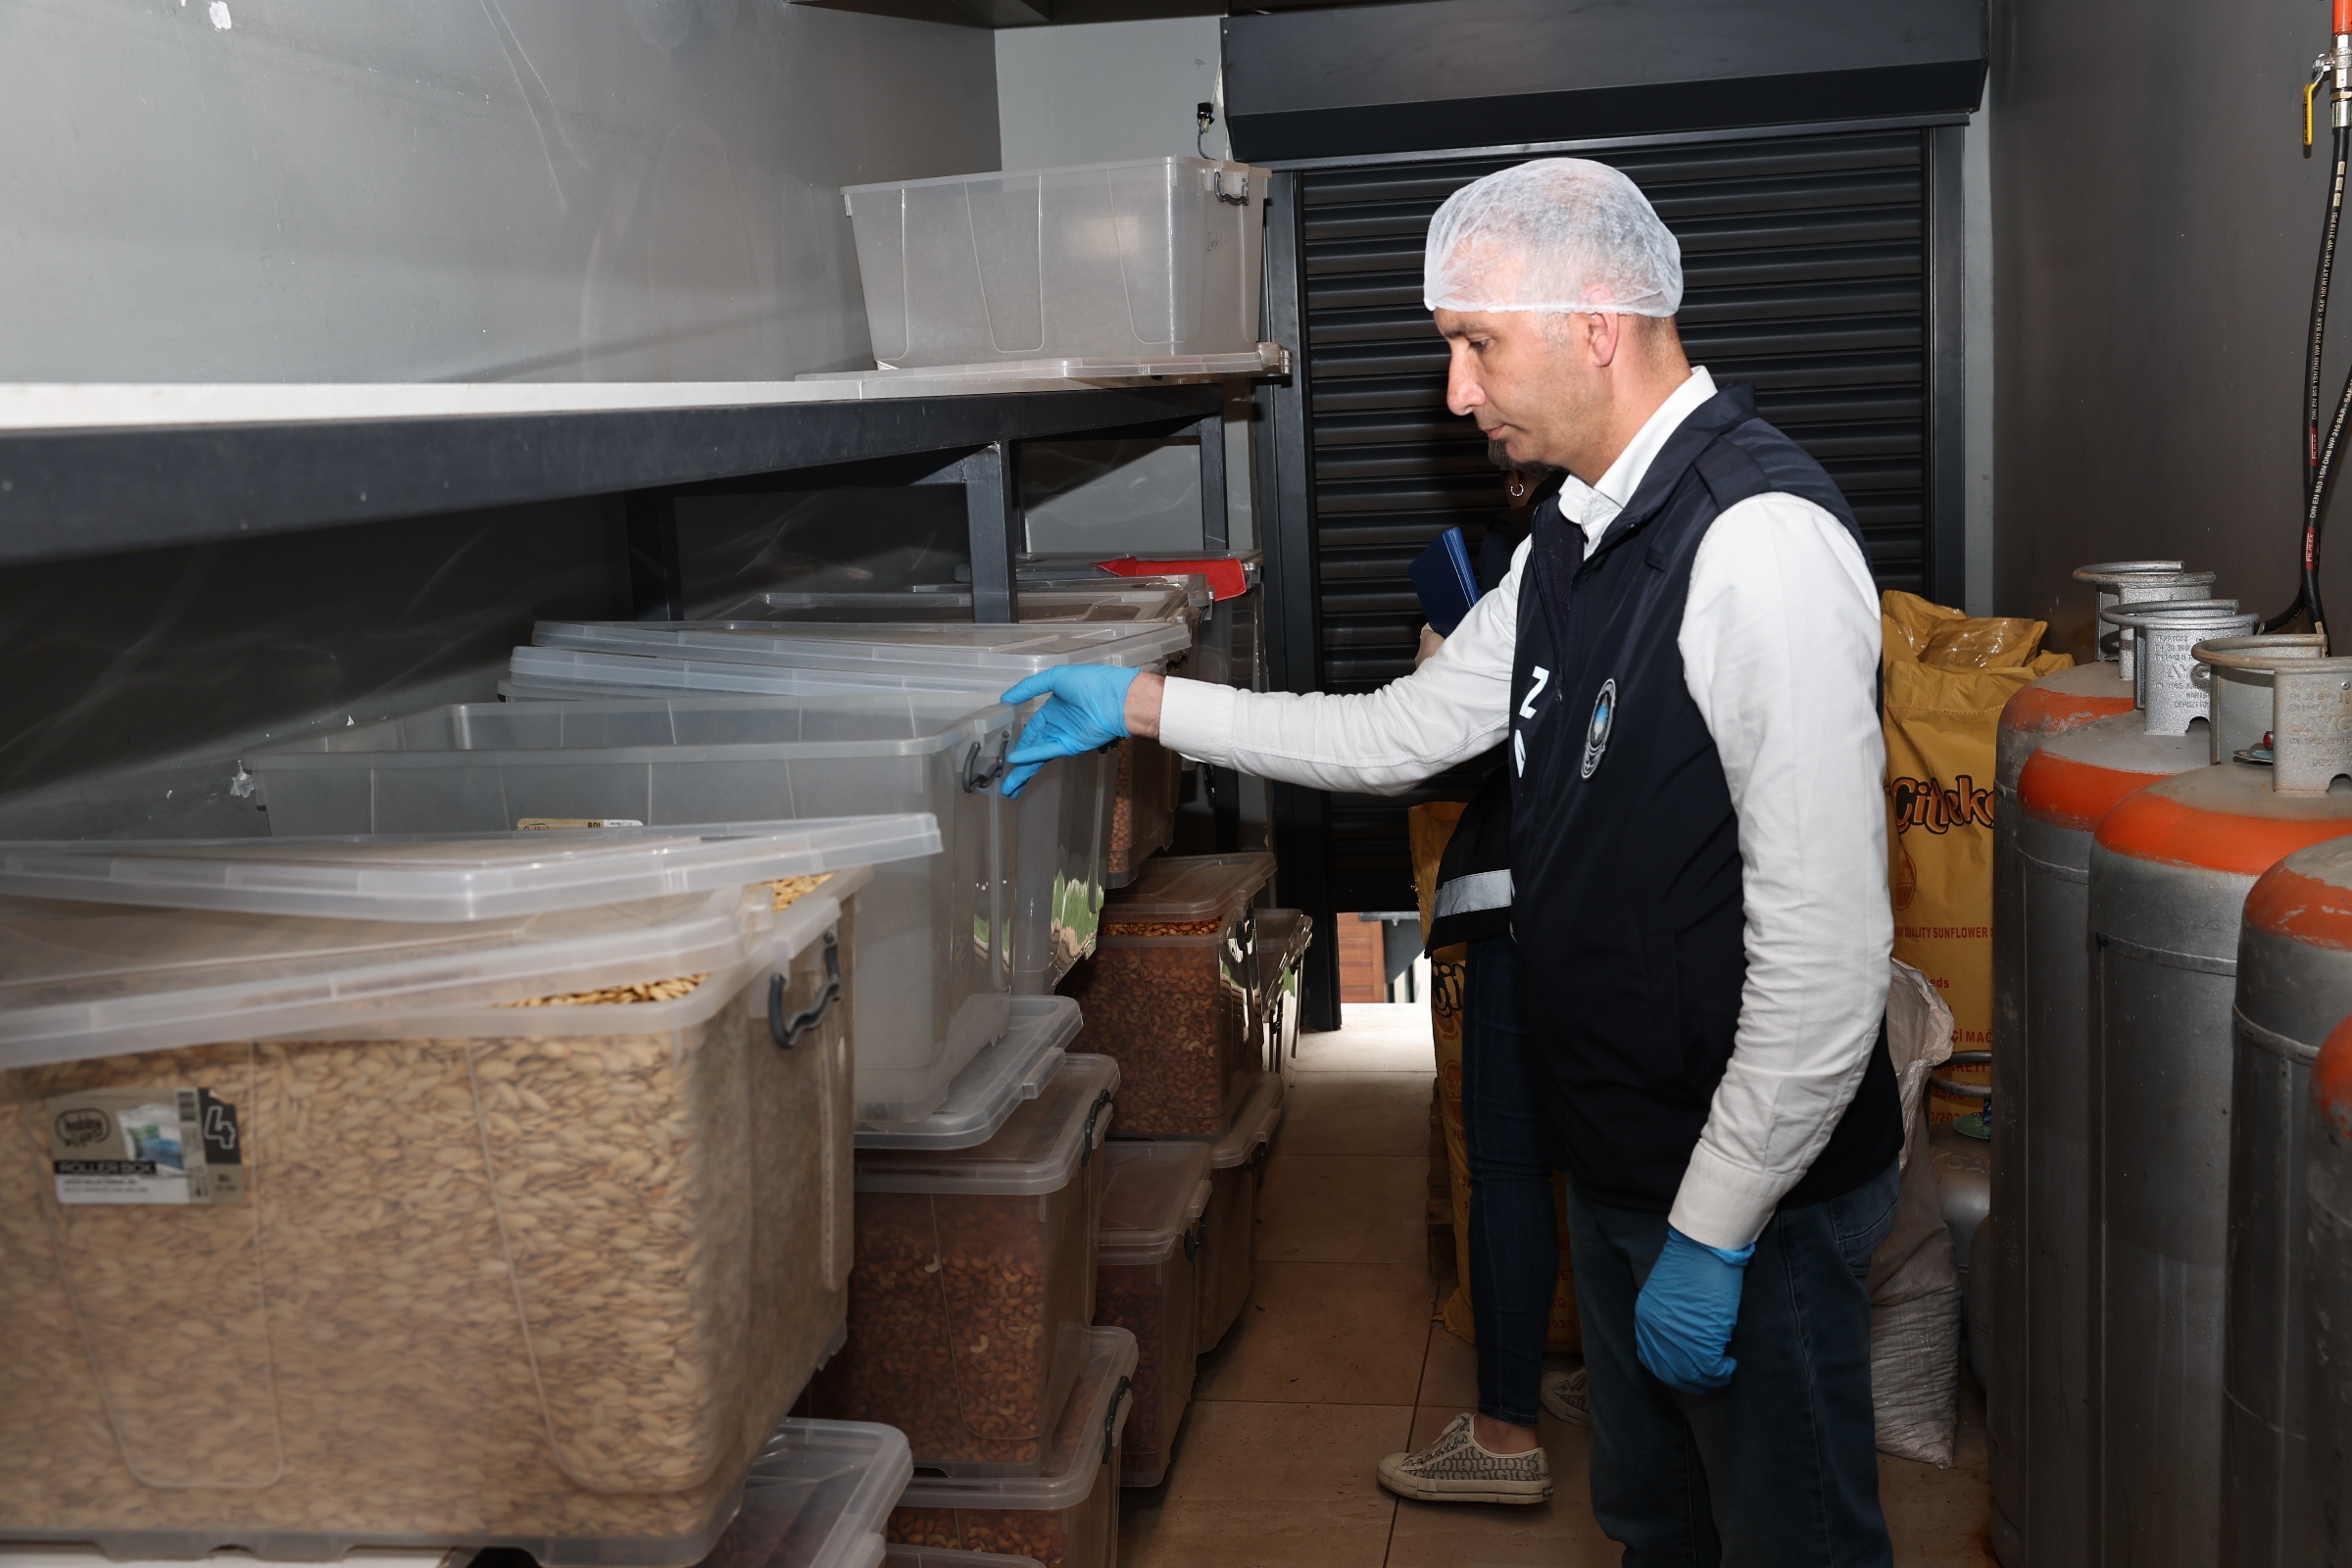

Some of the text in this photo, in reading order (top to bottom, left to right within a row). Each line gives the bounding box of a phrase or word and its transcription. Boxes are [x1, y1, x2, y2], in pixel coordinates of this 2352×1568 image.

[2315, 345, 2321, 356] WP
[2327, 239, 2334, 251] WP
[2336, 408, 2348, 423] BAR
[2331, 424, 2341, 437] 215
[2328, 437, 2336, 449] WP
[2323, 450, 2332, 465] DN8
[2315, 481, 2324, 494] 853
[2313, 494, 2320, 505] EN
[2164, 663, 2210, 680] AYG
[1905, 926, 1931, 938] QUALITY
[1933, 926, 1988, 939] SUNFLOWER
[1930, 977, 1950, 989] eds
[1966, 1029, 1993, 1044] MAĞ
[203, 1105, 237, 1150] 4
[59, 1162, 156, 1175] ROLLER BOX
[1547, 1319, 1575, 1330] 2025
